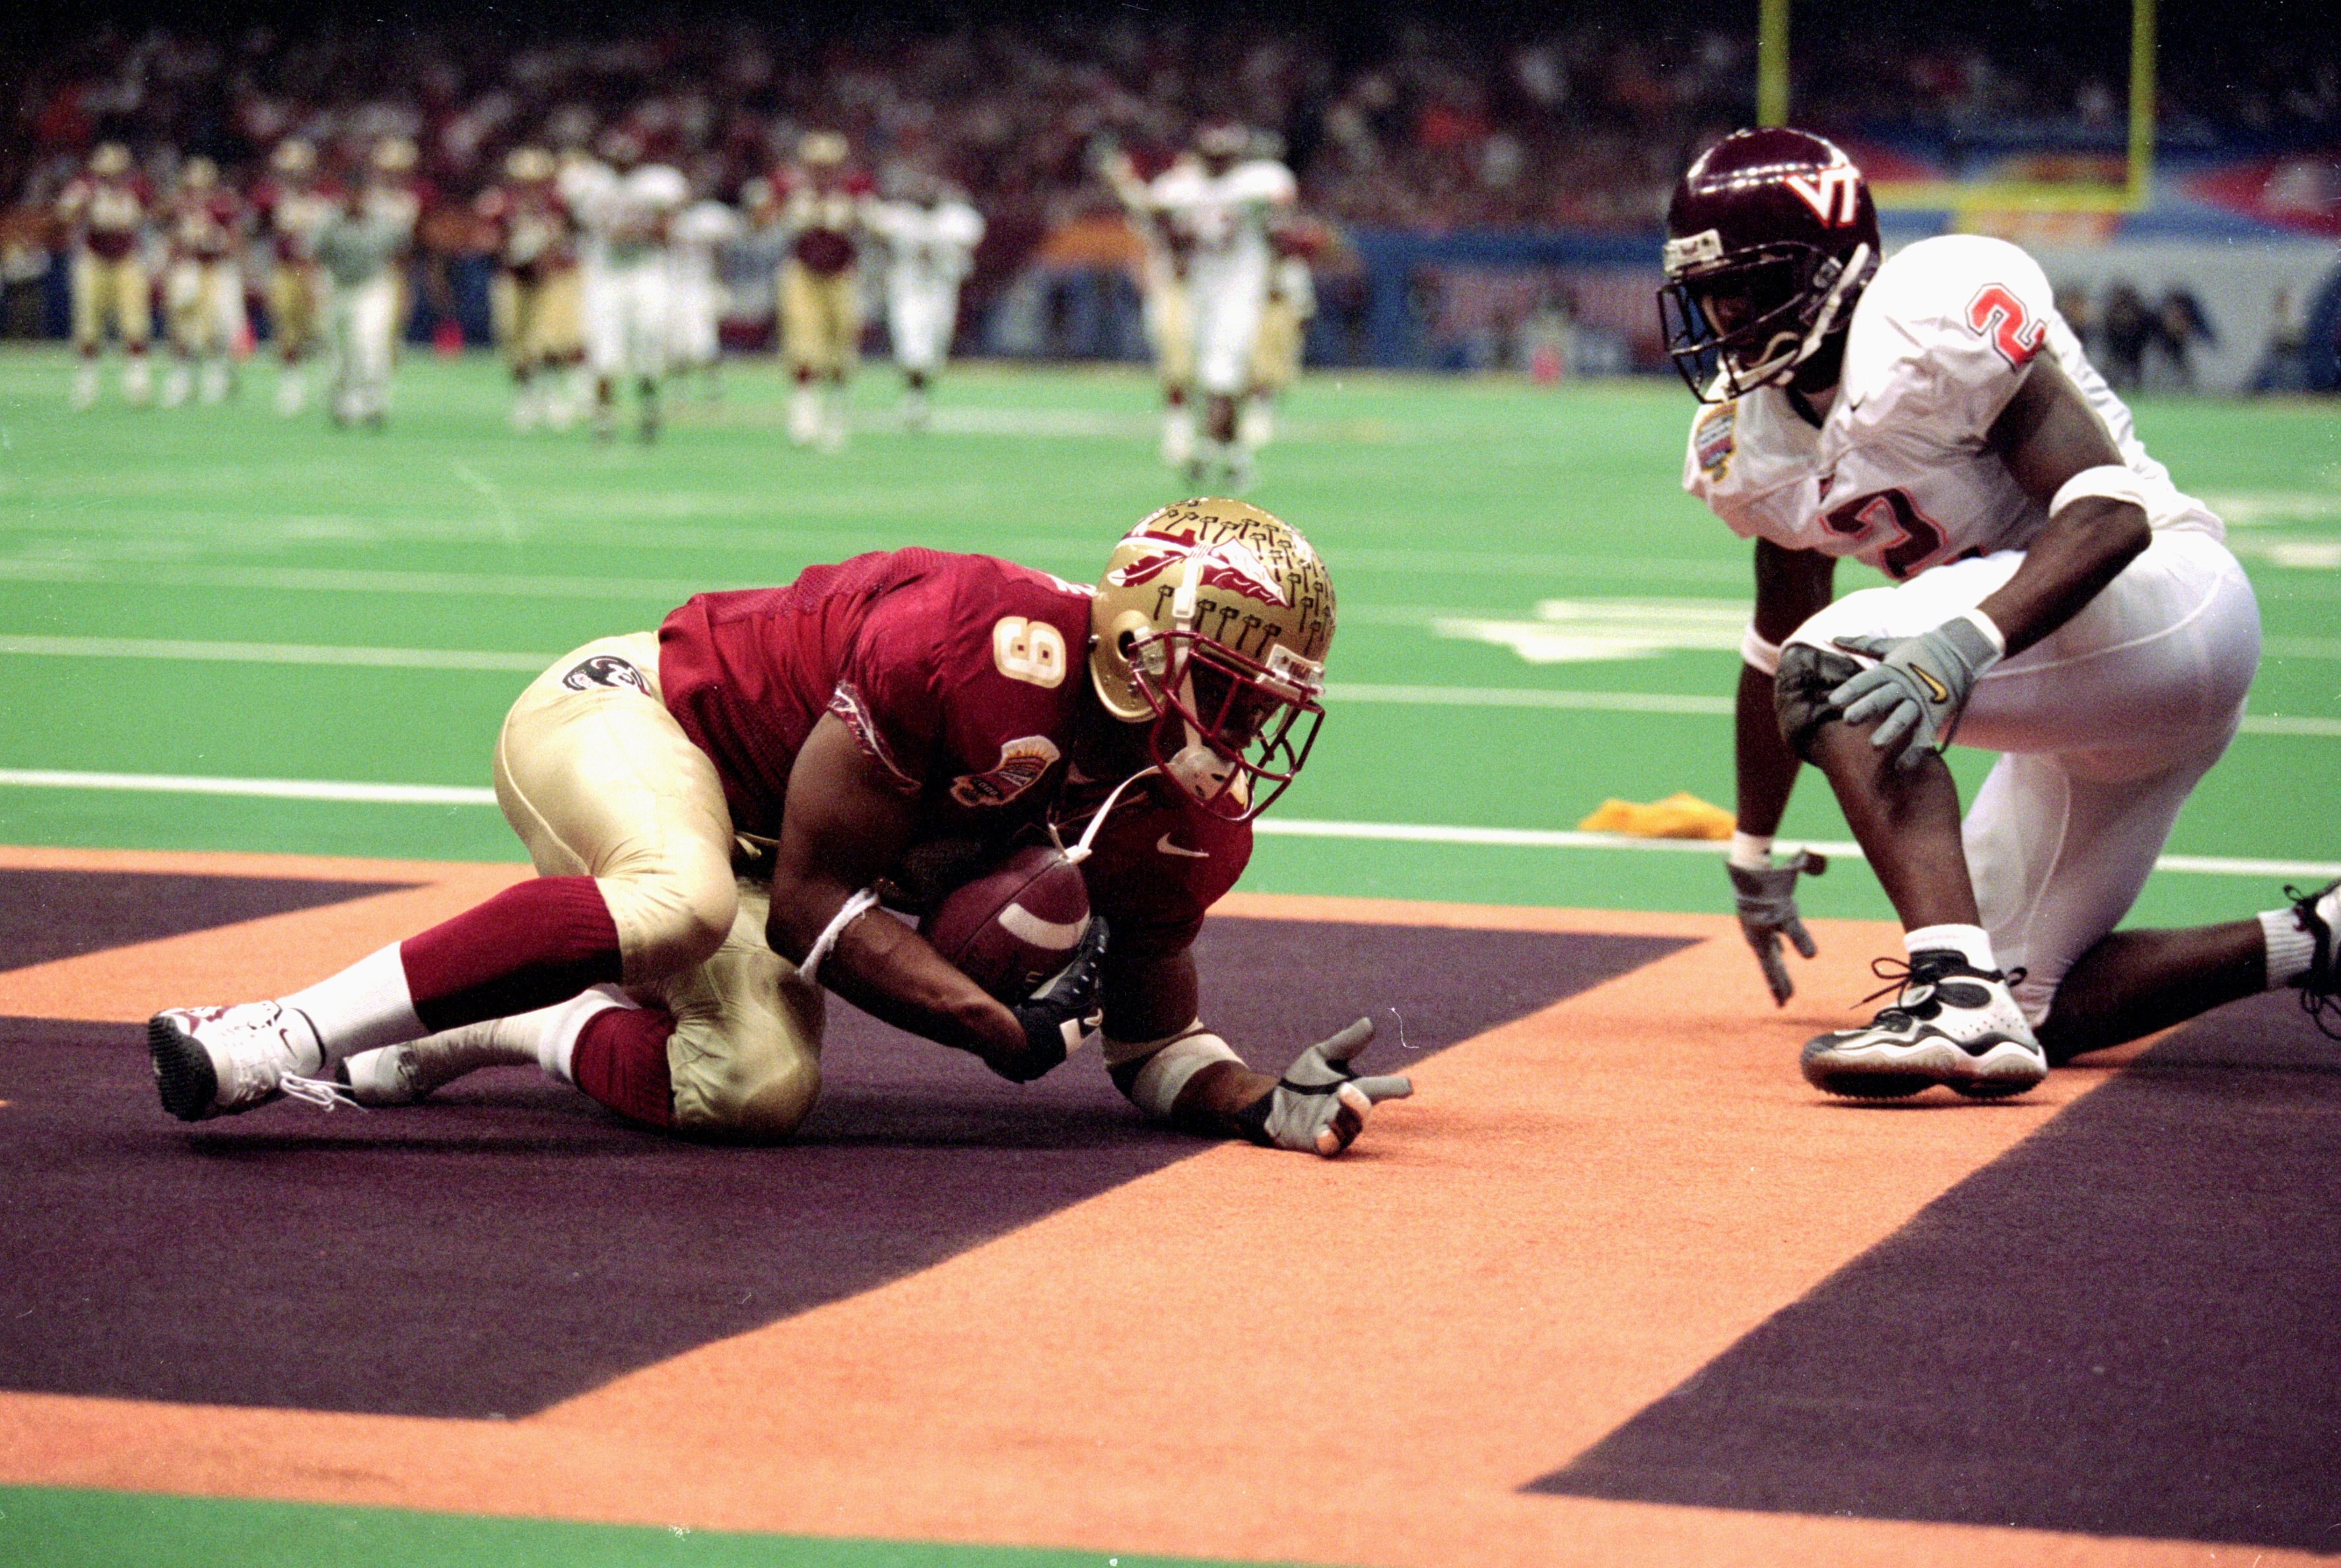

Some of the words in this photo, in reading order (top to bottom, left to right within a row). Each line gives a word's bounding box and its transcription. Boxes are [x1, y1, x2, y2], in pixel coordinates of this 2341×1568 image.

[1783, 162, 1860, 229] VT
[1965, 282, 2047, 372] 2
[1819, 486, 1989, 582] 2
[993, 616, 1067, 689] 9
